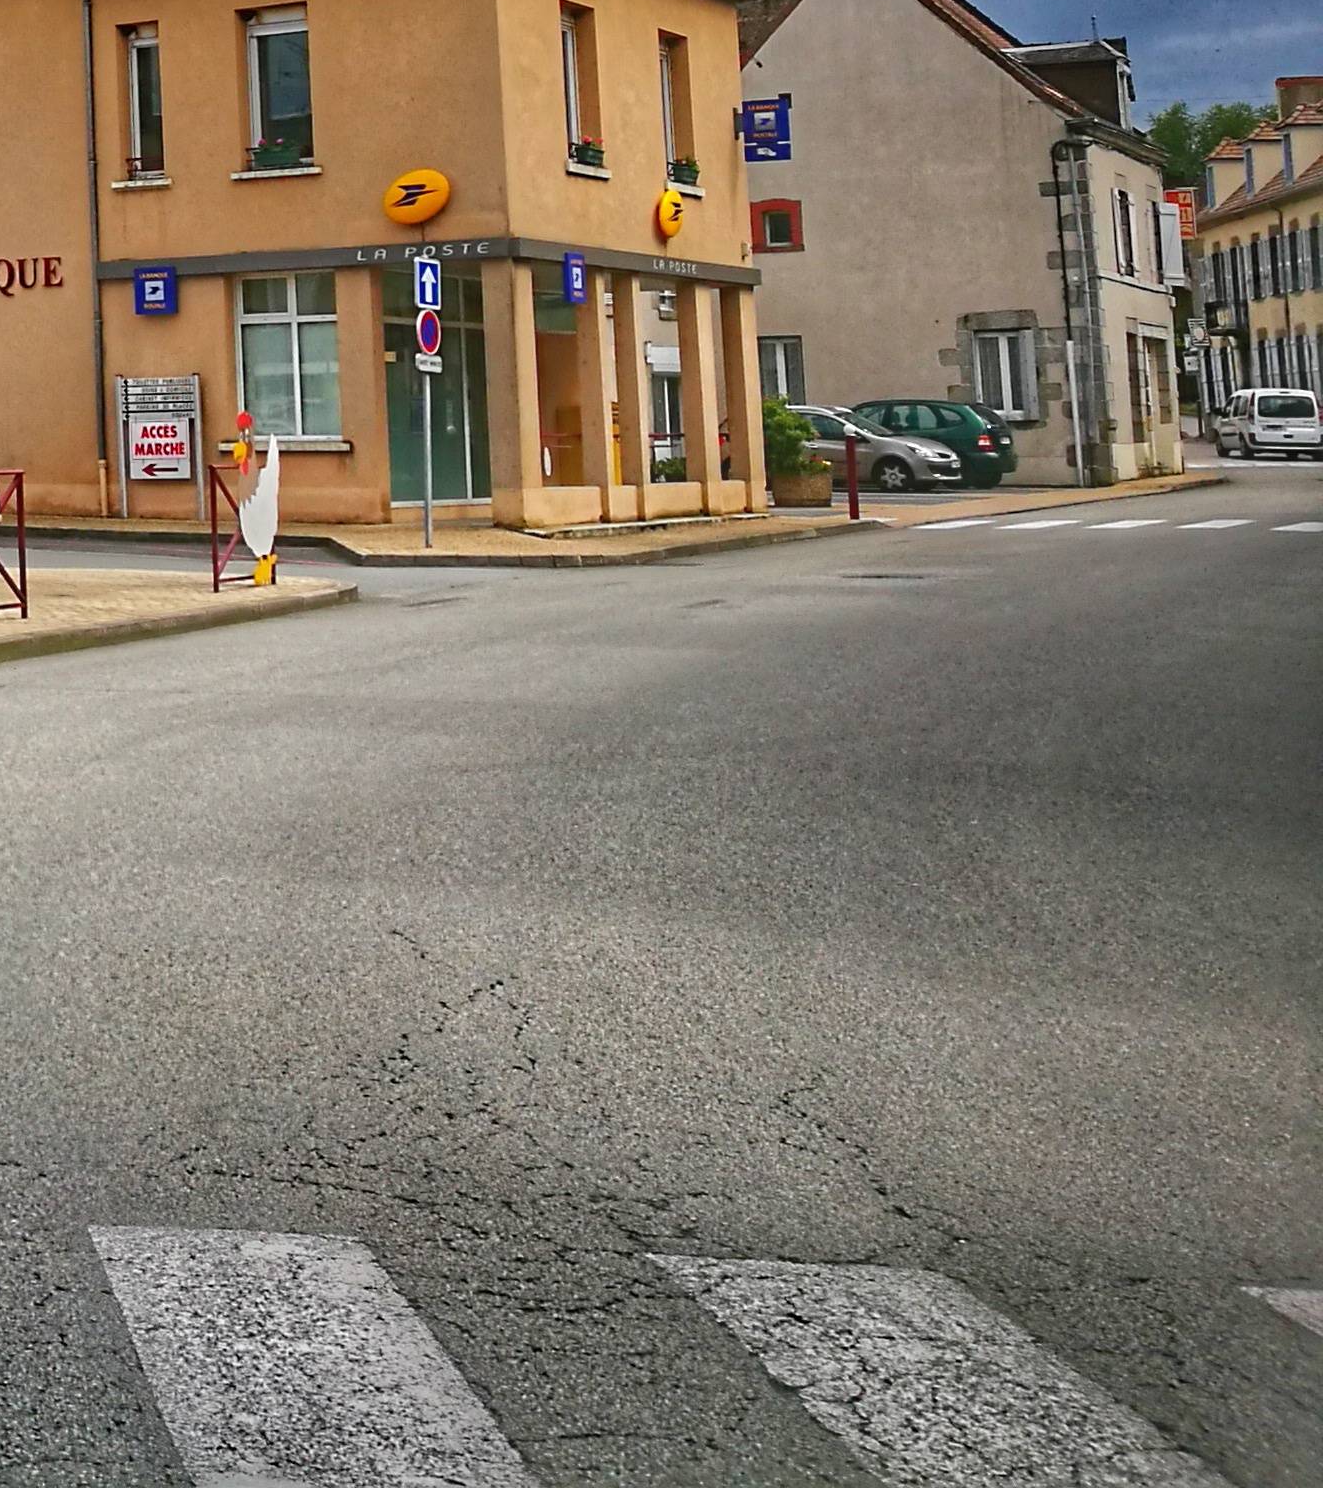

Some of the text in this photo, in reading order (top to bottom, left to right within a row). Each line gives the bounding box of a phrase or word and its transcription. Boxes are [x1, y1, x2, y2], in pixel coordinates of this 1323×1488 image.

[356, 242, 490, 262] LA POSTE
[653, 259, 697, 274] LA POSTE
